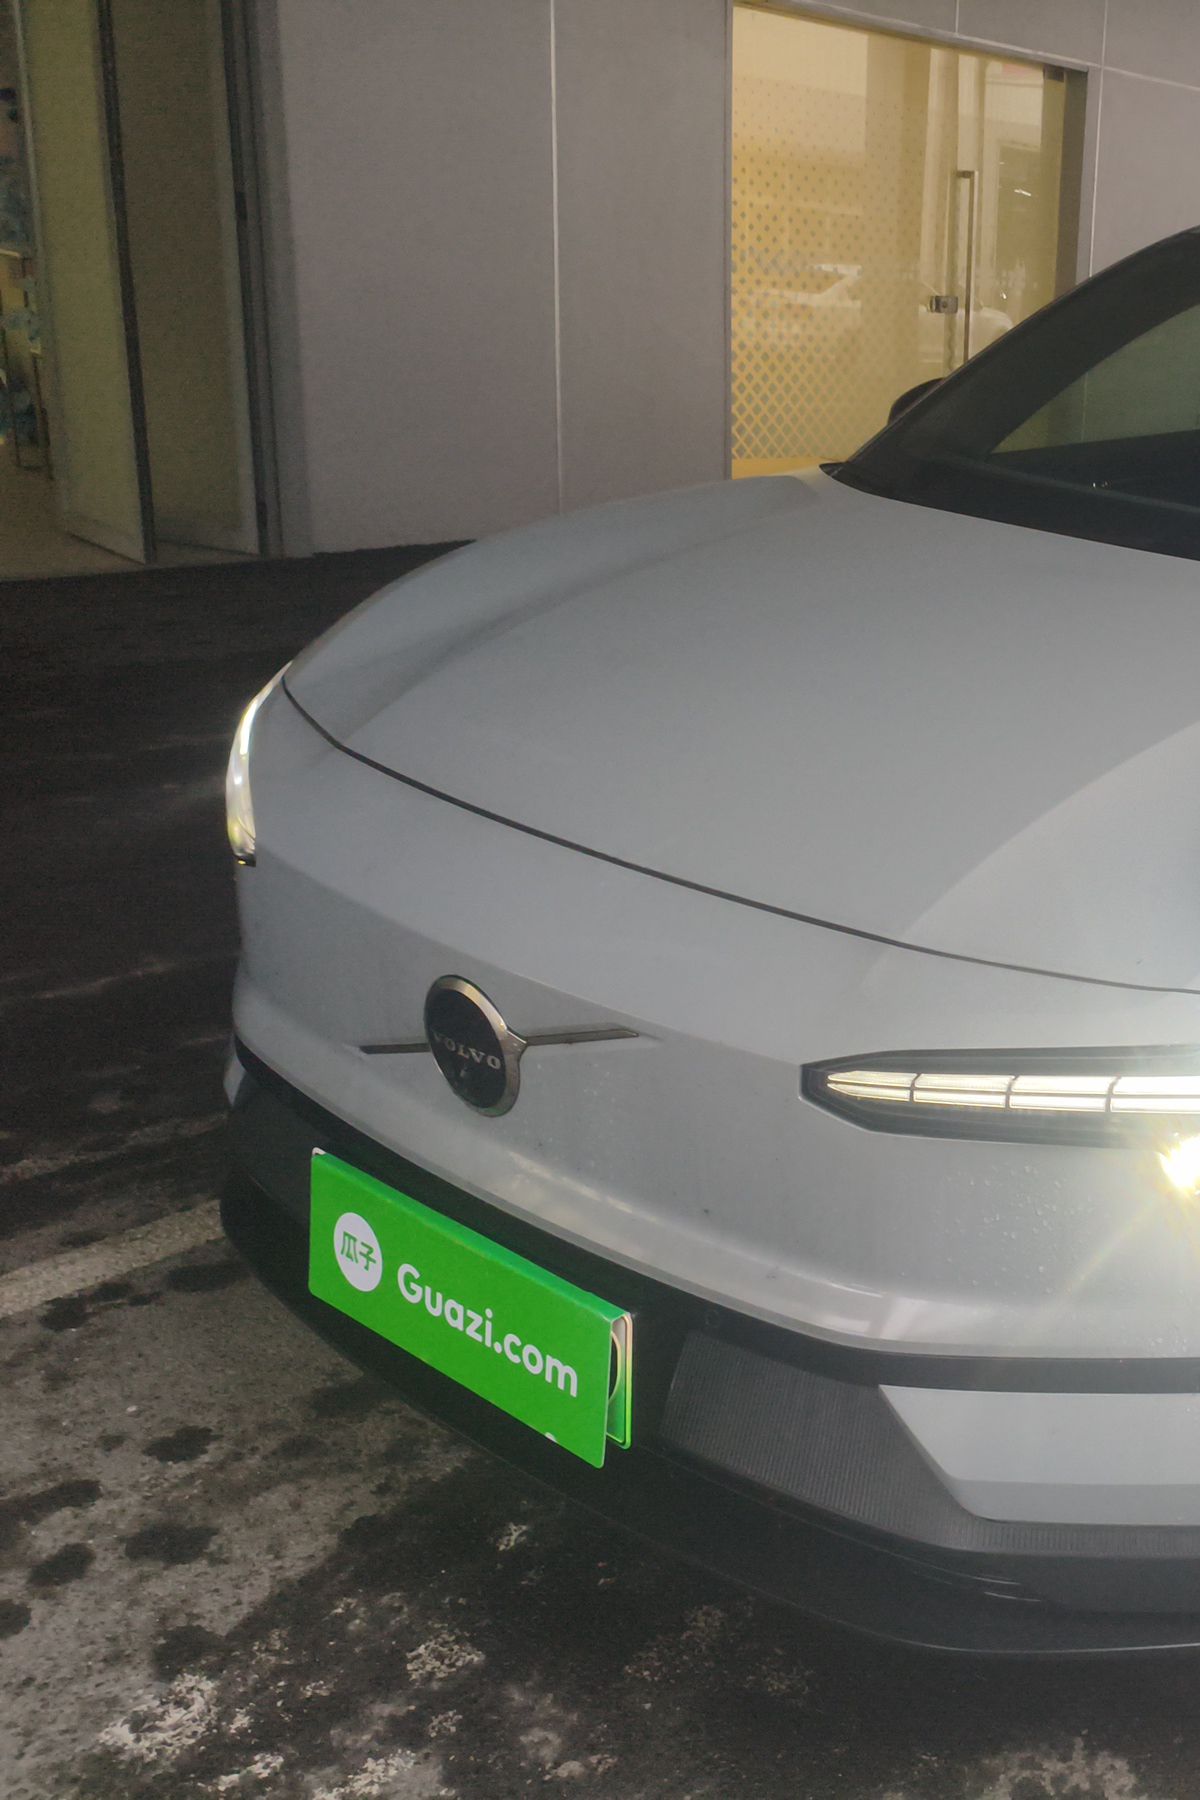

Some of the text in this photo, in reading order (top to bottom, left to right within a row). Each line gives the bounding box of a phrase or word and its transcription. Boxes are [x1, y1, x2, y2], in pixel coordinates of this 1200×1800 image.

[433, 1031, 501, 1070] VOLVO
[341, 1231, 376, 1271] 瓜子
[397, 1263, 578, 1398] Guazi.com
